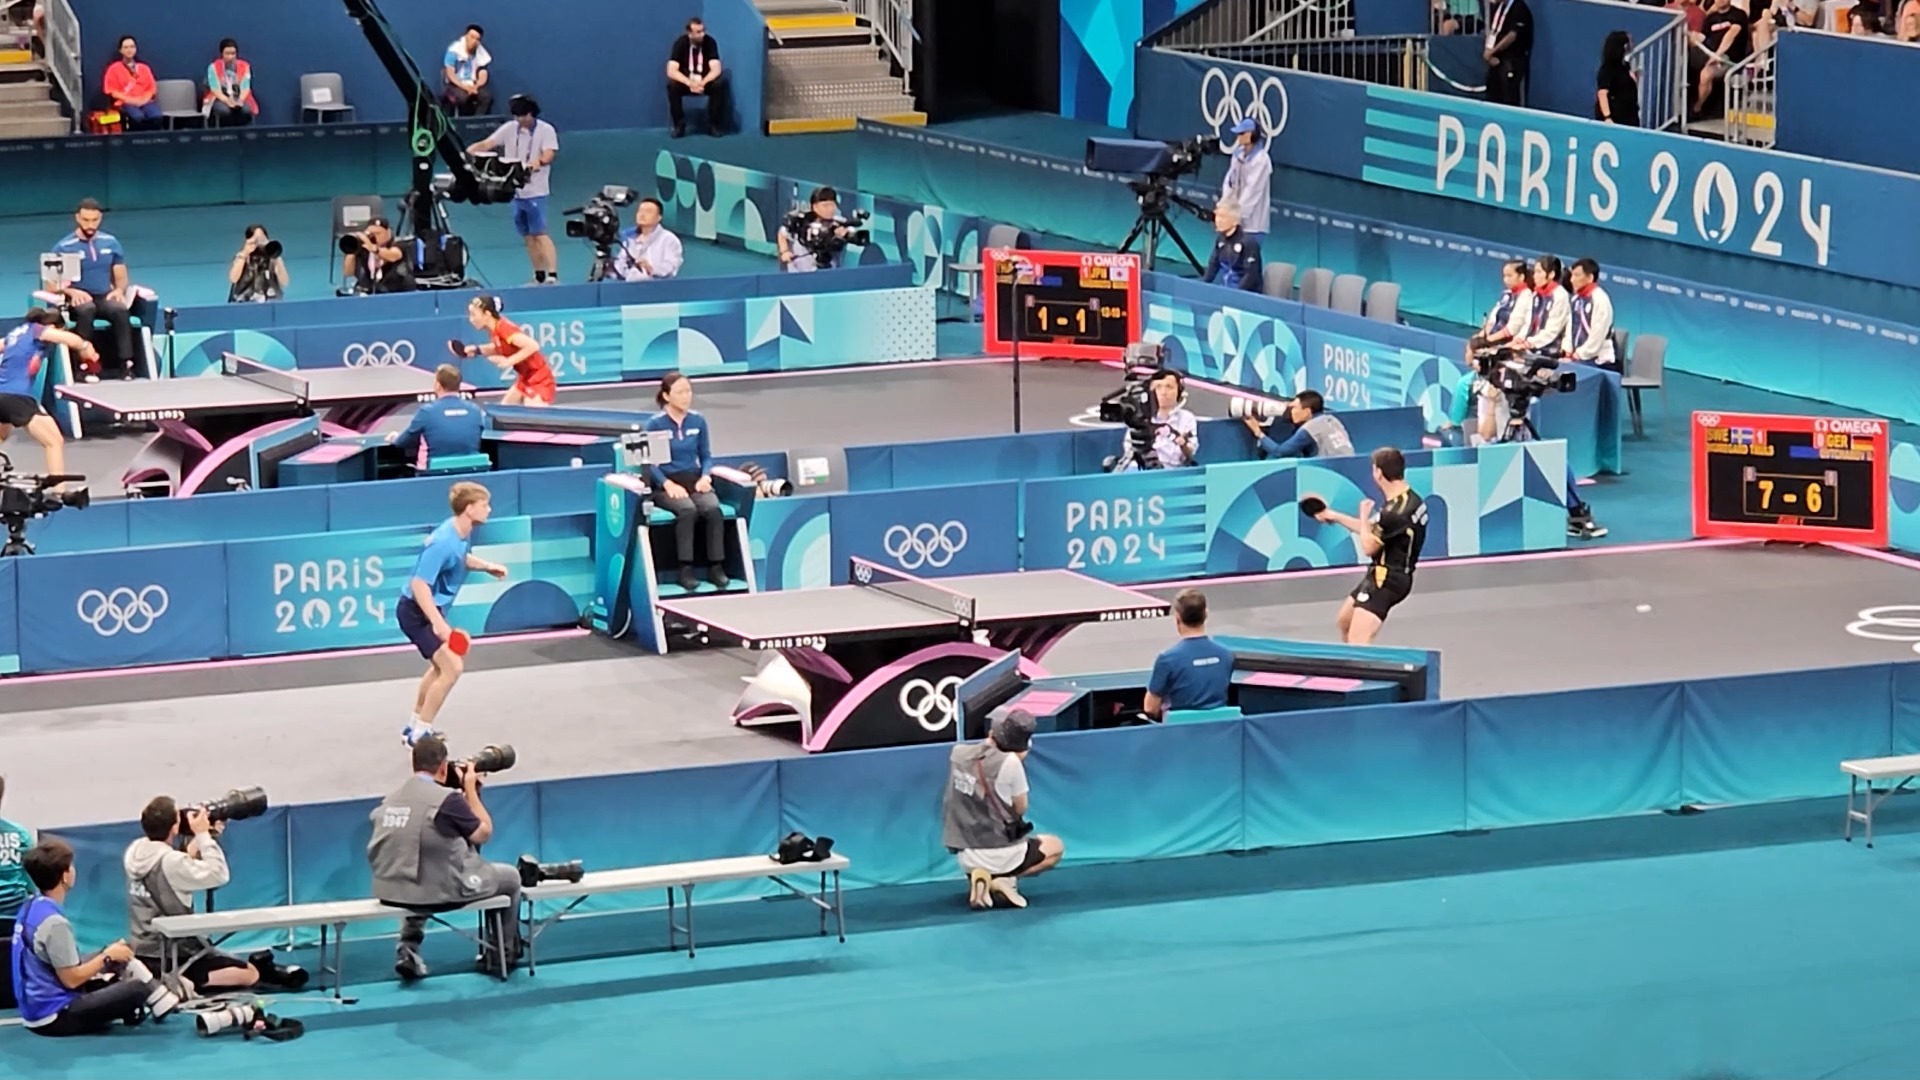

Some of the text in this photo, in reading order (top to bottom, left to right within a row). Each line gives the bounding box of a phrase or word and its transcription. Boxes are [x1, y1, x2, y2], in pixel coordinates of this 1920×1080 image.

[1647, 151, 1831, 266] 2024
[1094, 254, 1137, 268] OMEGA
[1037, 306, 1049, 331] 1
[1076, 308, 1087, 333] 1
[1324, 374, 1371, 409] 2024
[1826, 433, 1848, 449] GER
[1830, 420, 1883, 435] OMEGA
[1758, 480, 1774, 509] 7
[1806, 482, 1822, 513] 6
[1067, 532, 1166, 569] 2024
[275, 594, 385, 633] 2024
[1100, 608, 1165, 621] PARIS 2024
[759, 638, 793, 650] PARIS
